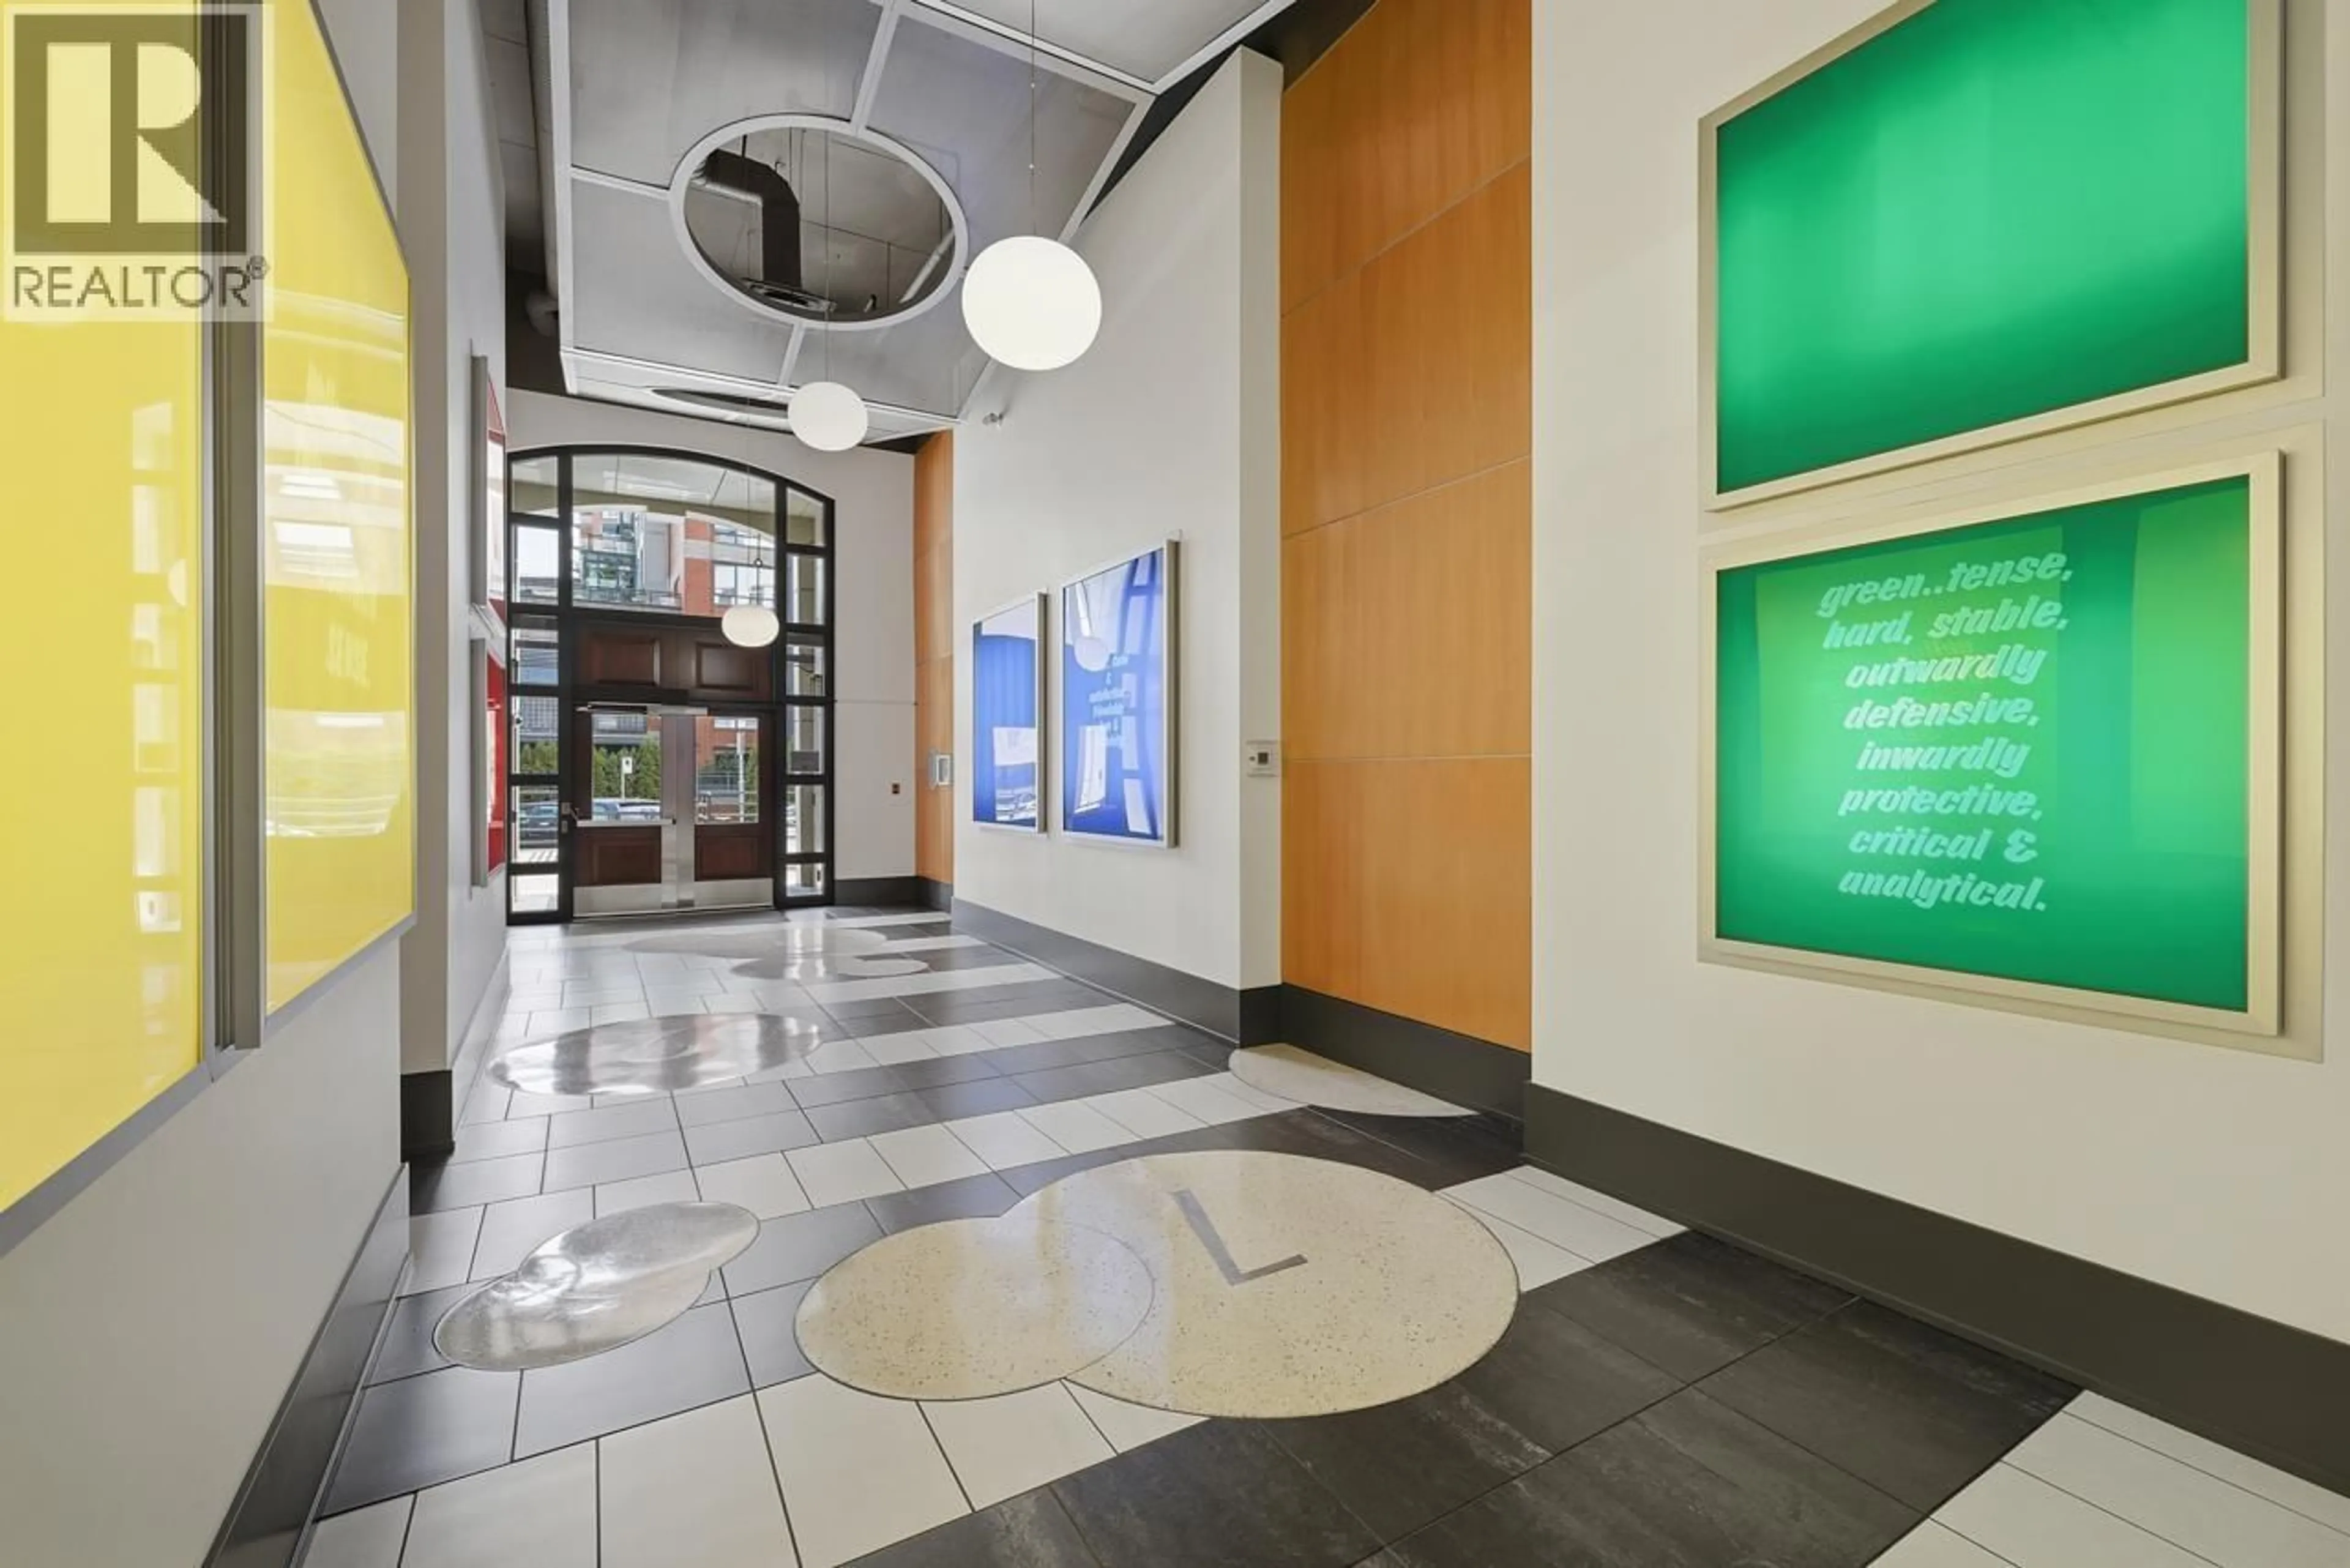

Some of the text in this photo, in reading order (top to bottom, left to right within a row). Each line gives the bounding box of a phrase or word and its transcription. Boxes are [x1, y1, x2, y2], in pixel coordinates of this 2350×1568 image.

[1845, 644, 2048, 688] outwardly
[1856, 736, 2031, 778] inwardly
[1848, 825, 2038, 864] critical &
[1838, 868, 2046, 911] analytical.
